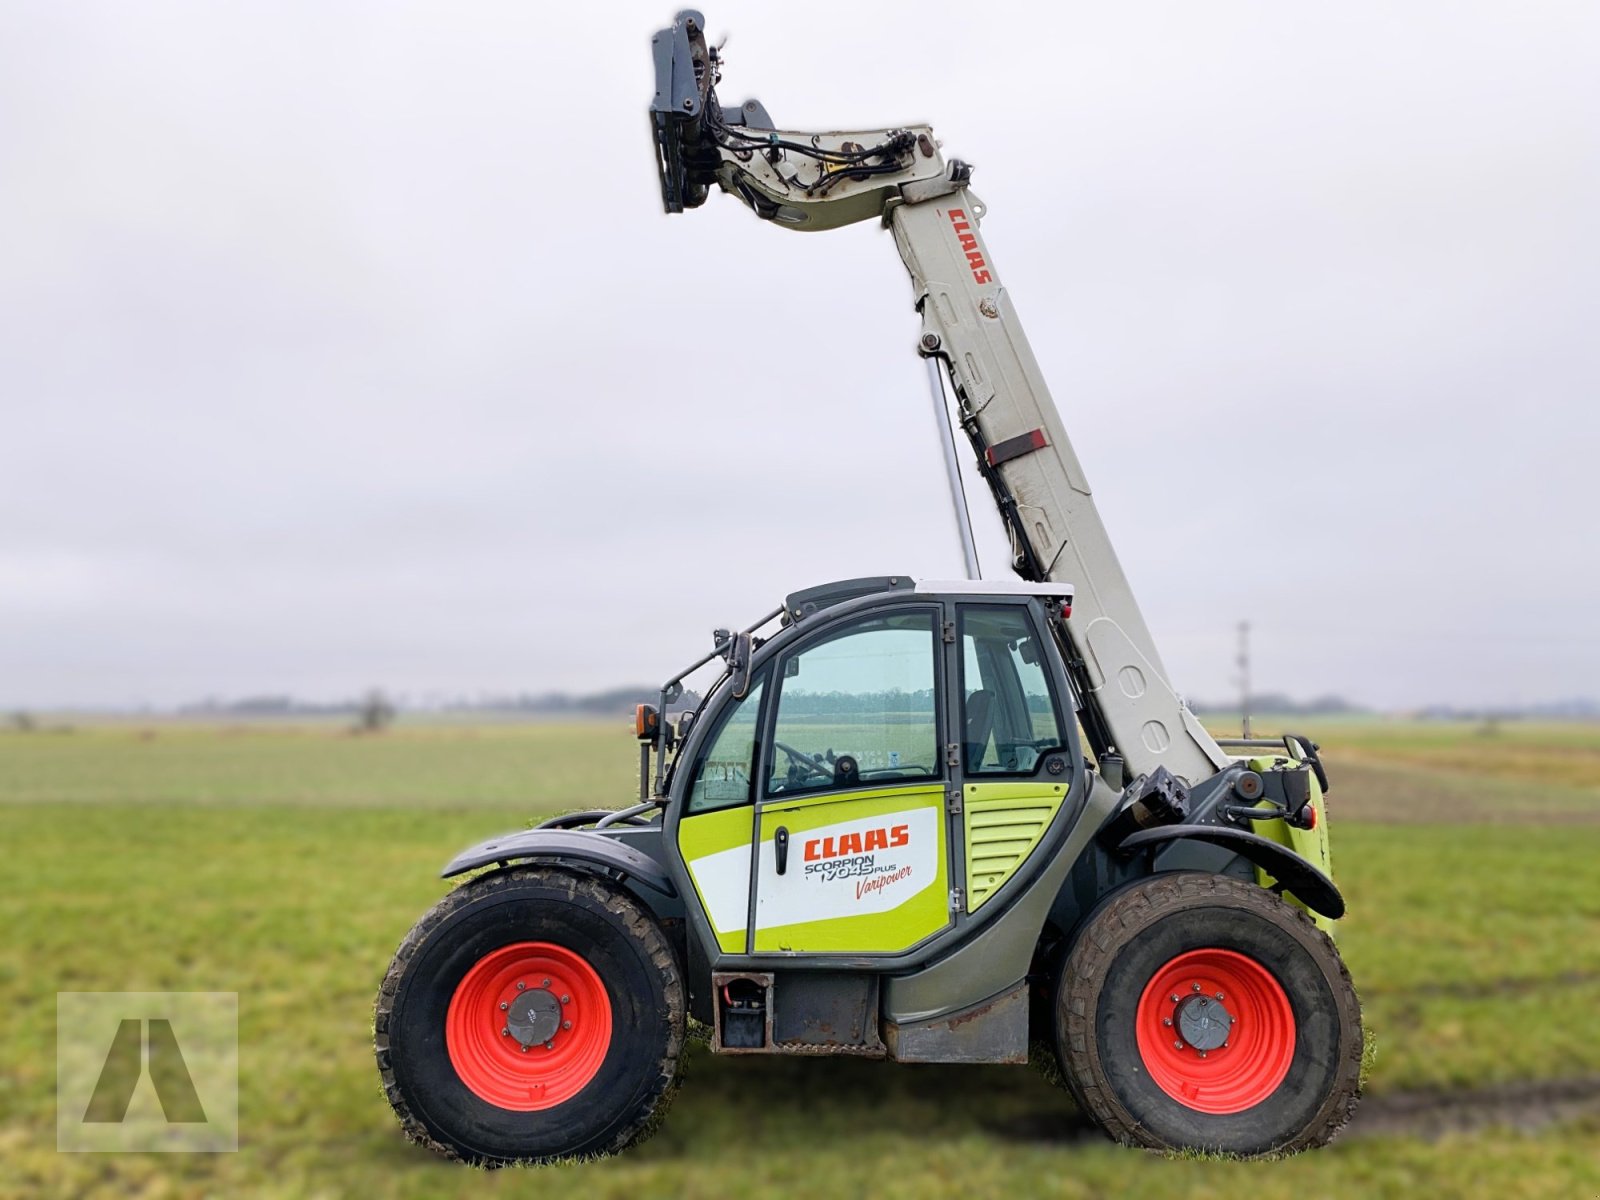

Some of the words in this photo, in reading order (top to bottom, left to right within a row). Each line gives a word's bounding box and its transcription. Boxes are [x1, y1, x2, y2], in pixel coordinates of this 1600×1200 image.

[948, 208, 993, 285] CLAAS
[803, 824, 909, 862] CLAAS
[804, 855, 875, 875] SCORPION
[856, 865, 913, 900] Varipower
[874, 864, 897, 873] PLUS
